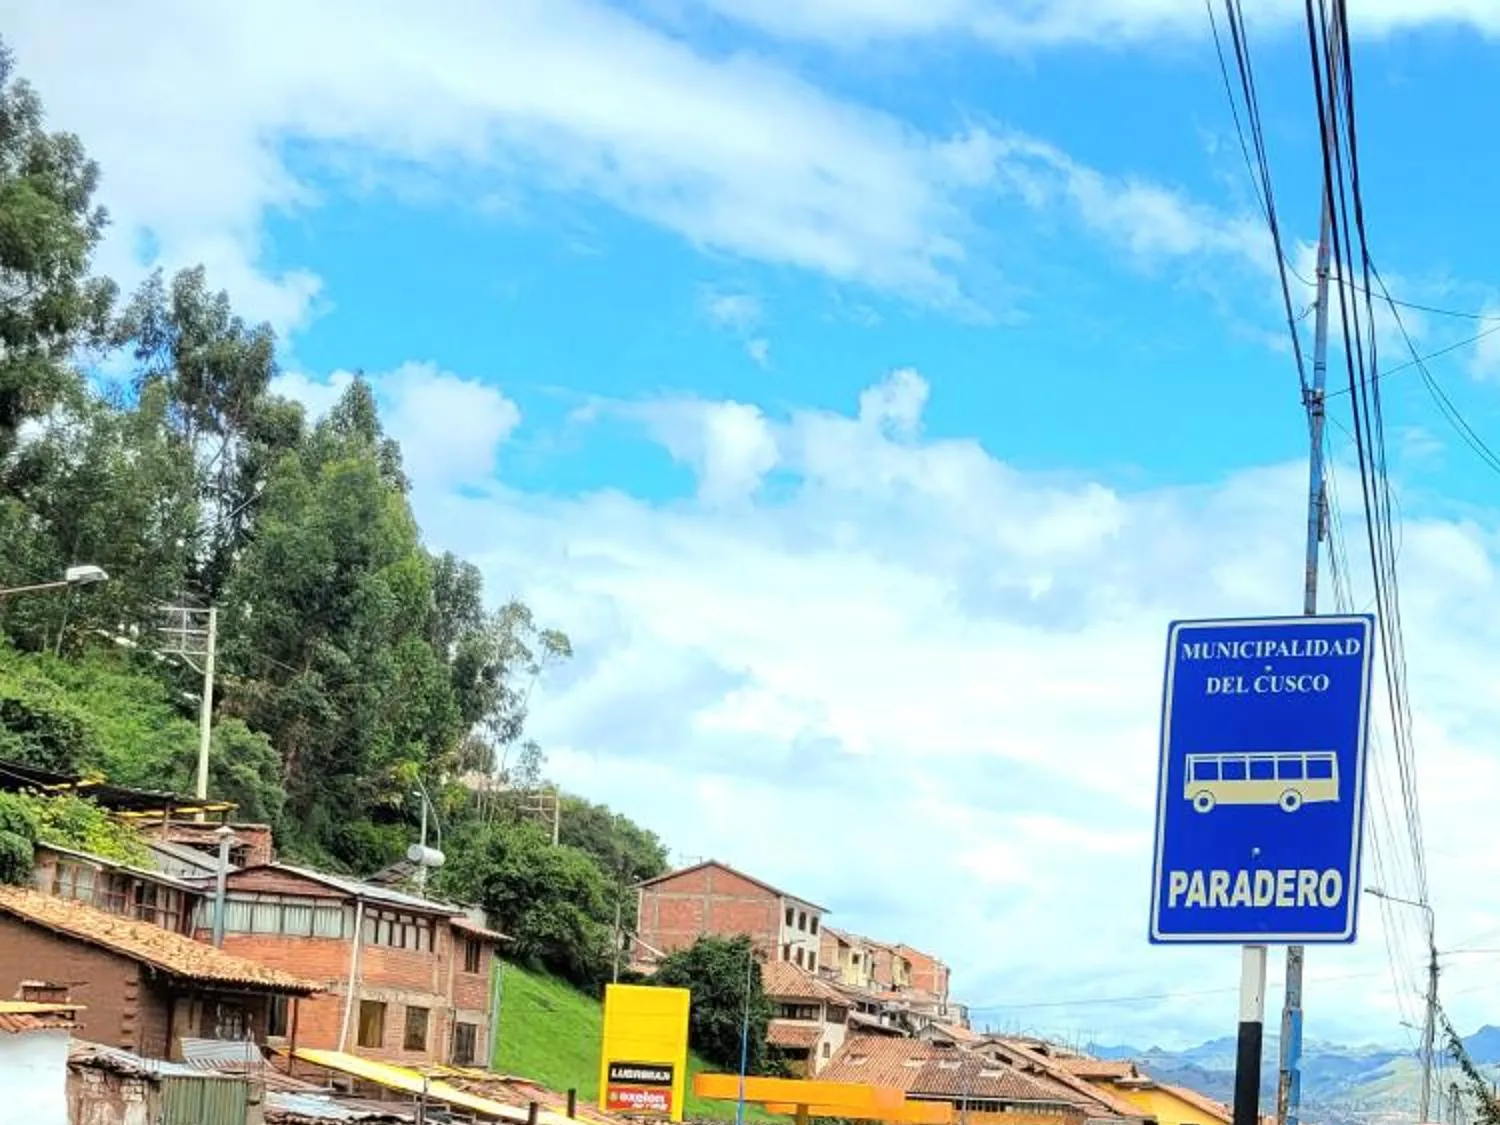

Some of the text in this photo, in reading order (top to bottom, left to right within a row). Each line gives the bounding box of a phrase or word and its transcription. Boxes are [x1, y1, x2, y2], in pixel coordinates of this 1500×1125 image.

[1181, 637, 1361, 660] MUNICIPALIDAD
[1205, 673, 1330, 695] DEL CUSCO
[1167, 868, 1343, 909] PARADERO
